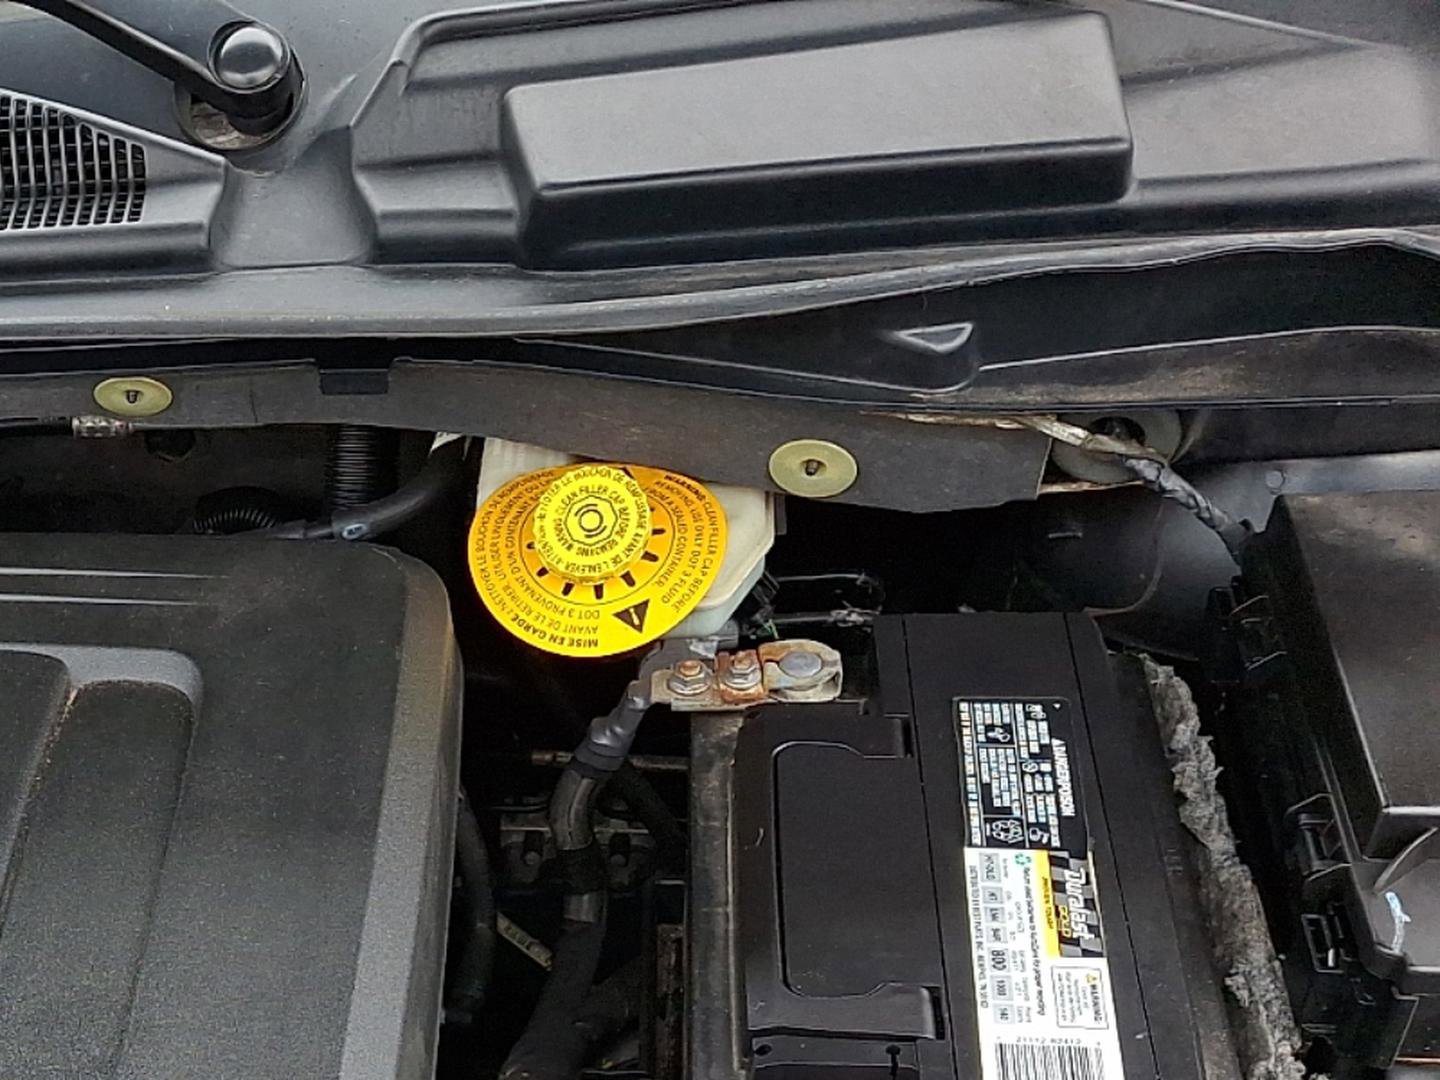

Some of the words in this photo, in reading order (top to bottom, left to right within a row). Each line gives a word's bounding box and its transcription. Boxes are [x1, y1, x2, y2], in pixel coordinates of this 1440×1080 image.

[577, 610, 601, 621] DOT
[511, 612, 548, 640] GARDE
[563, 623, 599, 634] AVANT
[548, 633, 566, 646] EN
[567, 637, 599, 648] MISE
[1063, 866, 1096, 940] Duralast
[1057, 904, 1071, 937] GOLD
